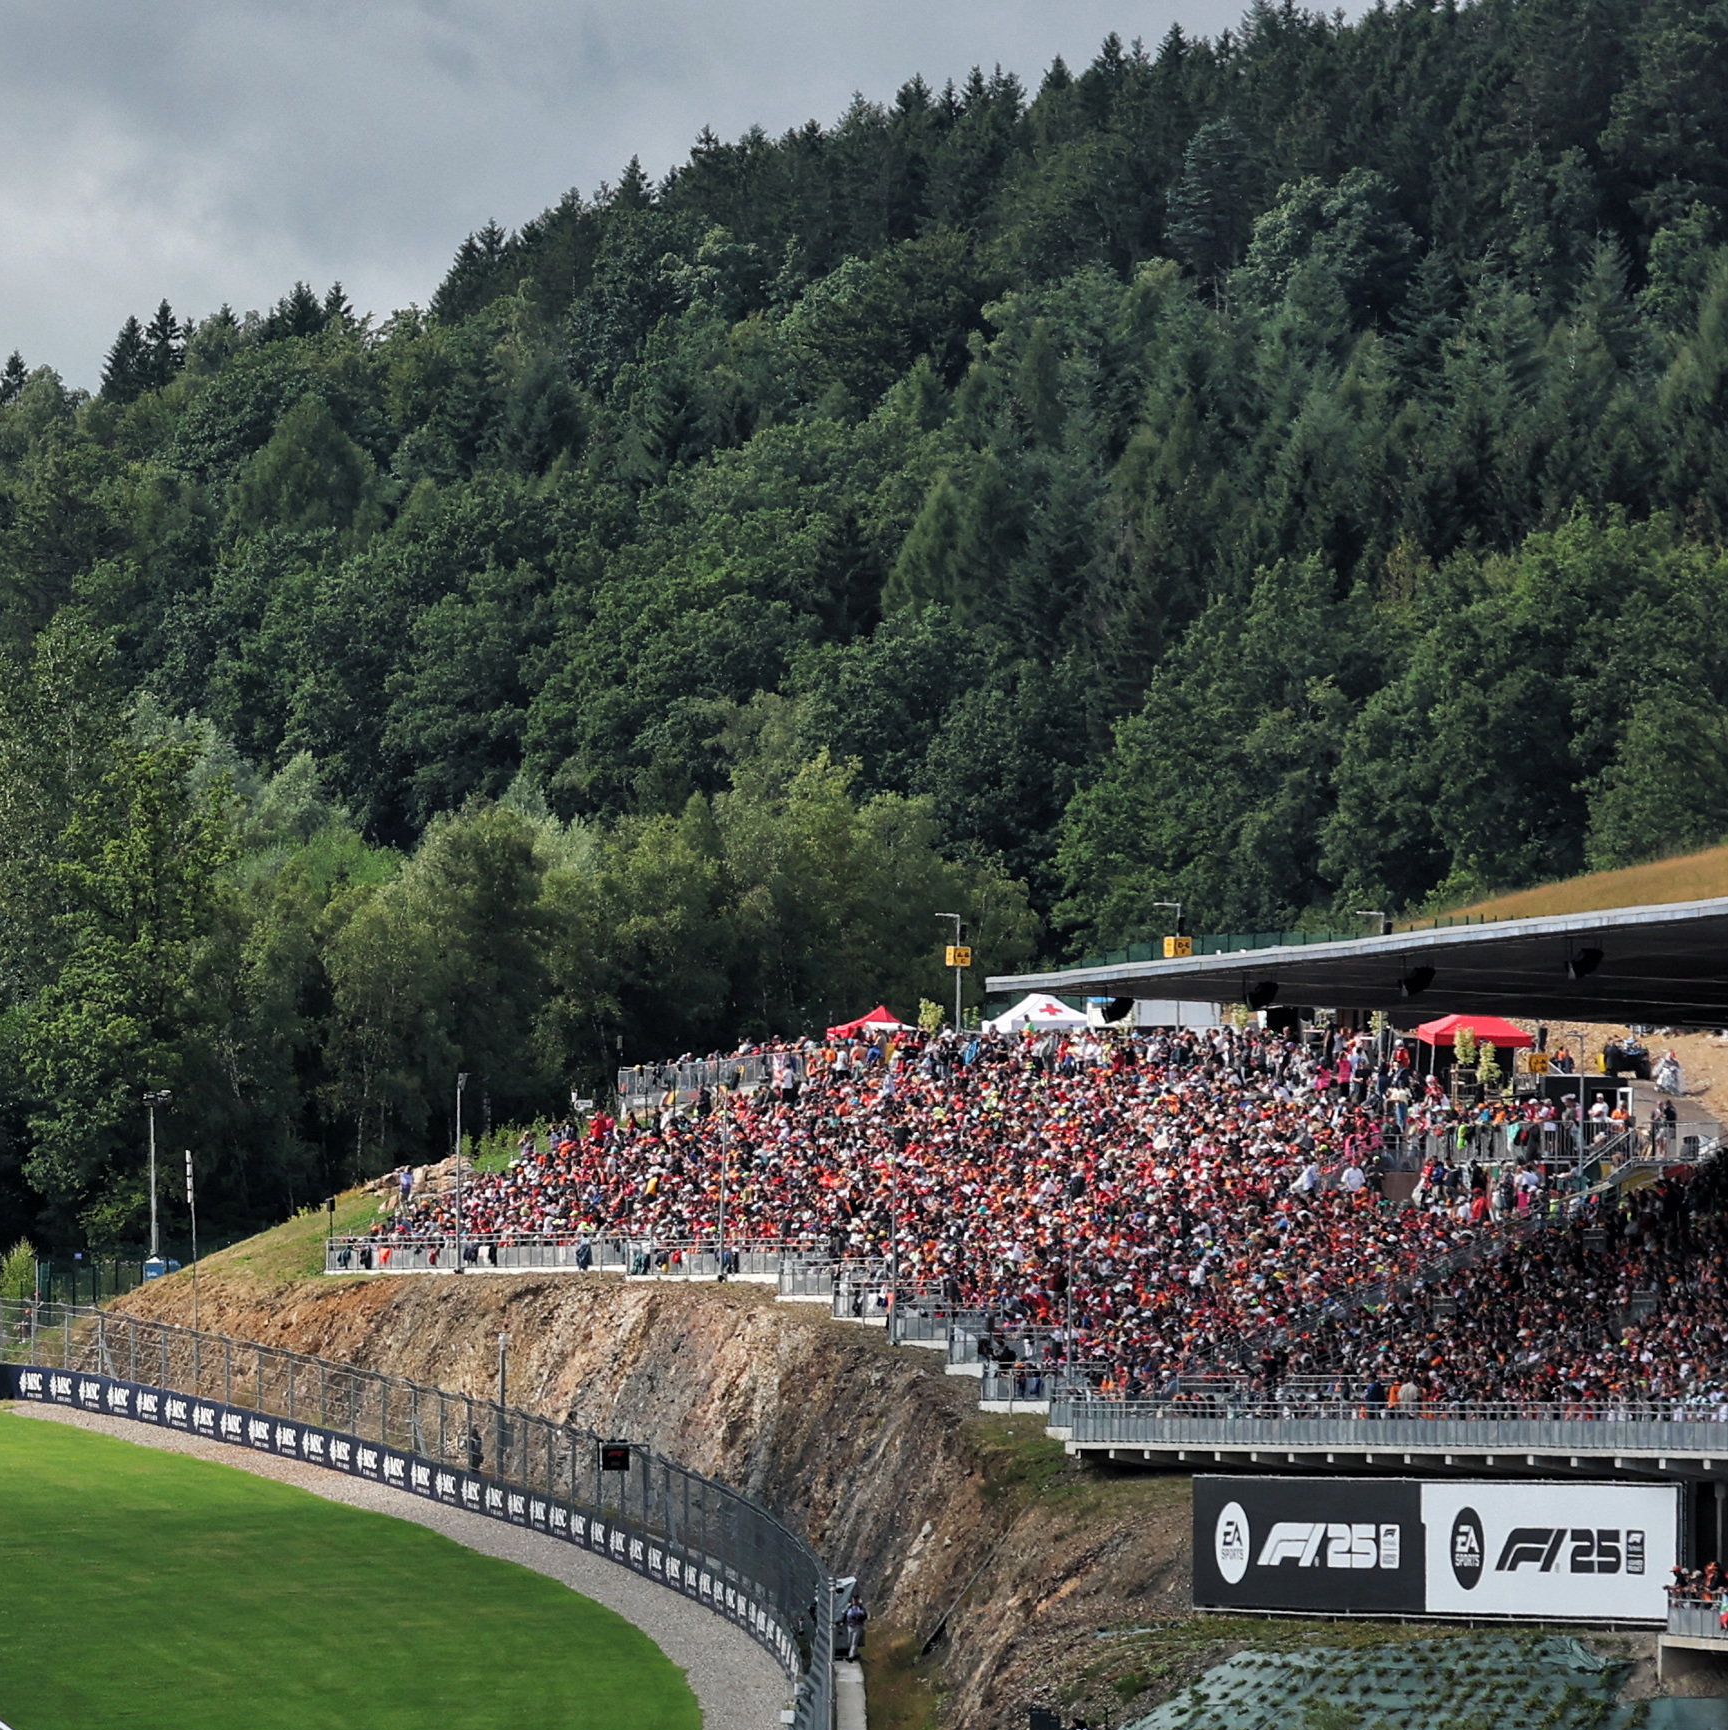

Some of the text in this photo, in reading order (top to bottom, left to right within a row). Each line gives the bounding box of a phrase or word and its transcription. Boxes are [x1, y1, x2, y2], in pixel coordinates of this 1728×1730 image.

[1224, 1521, 1243, 1545] EA
[1457, 1524, 1478, 1550] EA
[1221, 1548, 1243, 1560] SPORTS
[1326, 1524, 1377, 1568] 25
[1570, 1529, 1622, 1573] 25
[1455, 1553, 1480, 1567] SPORTS
